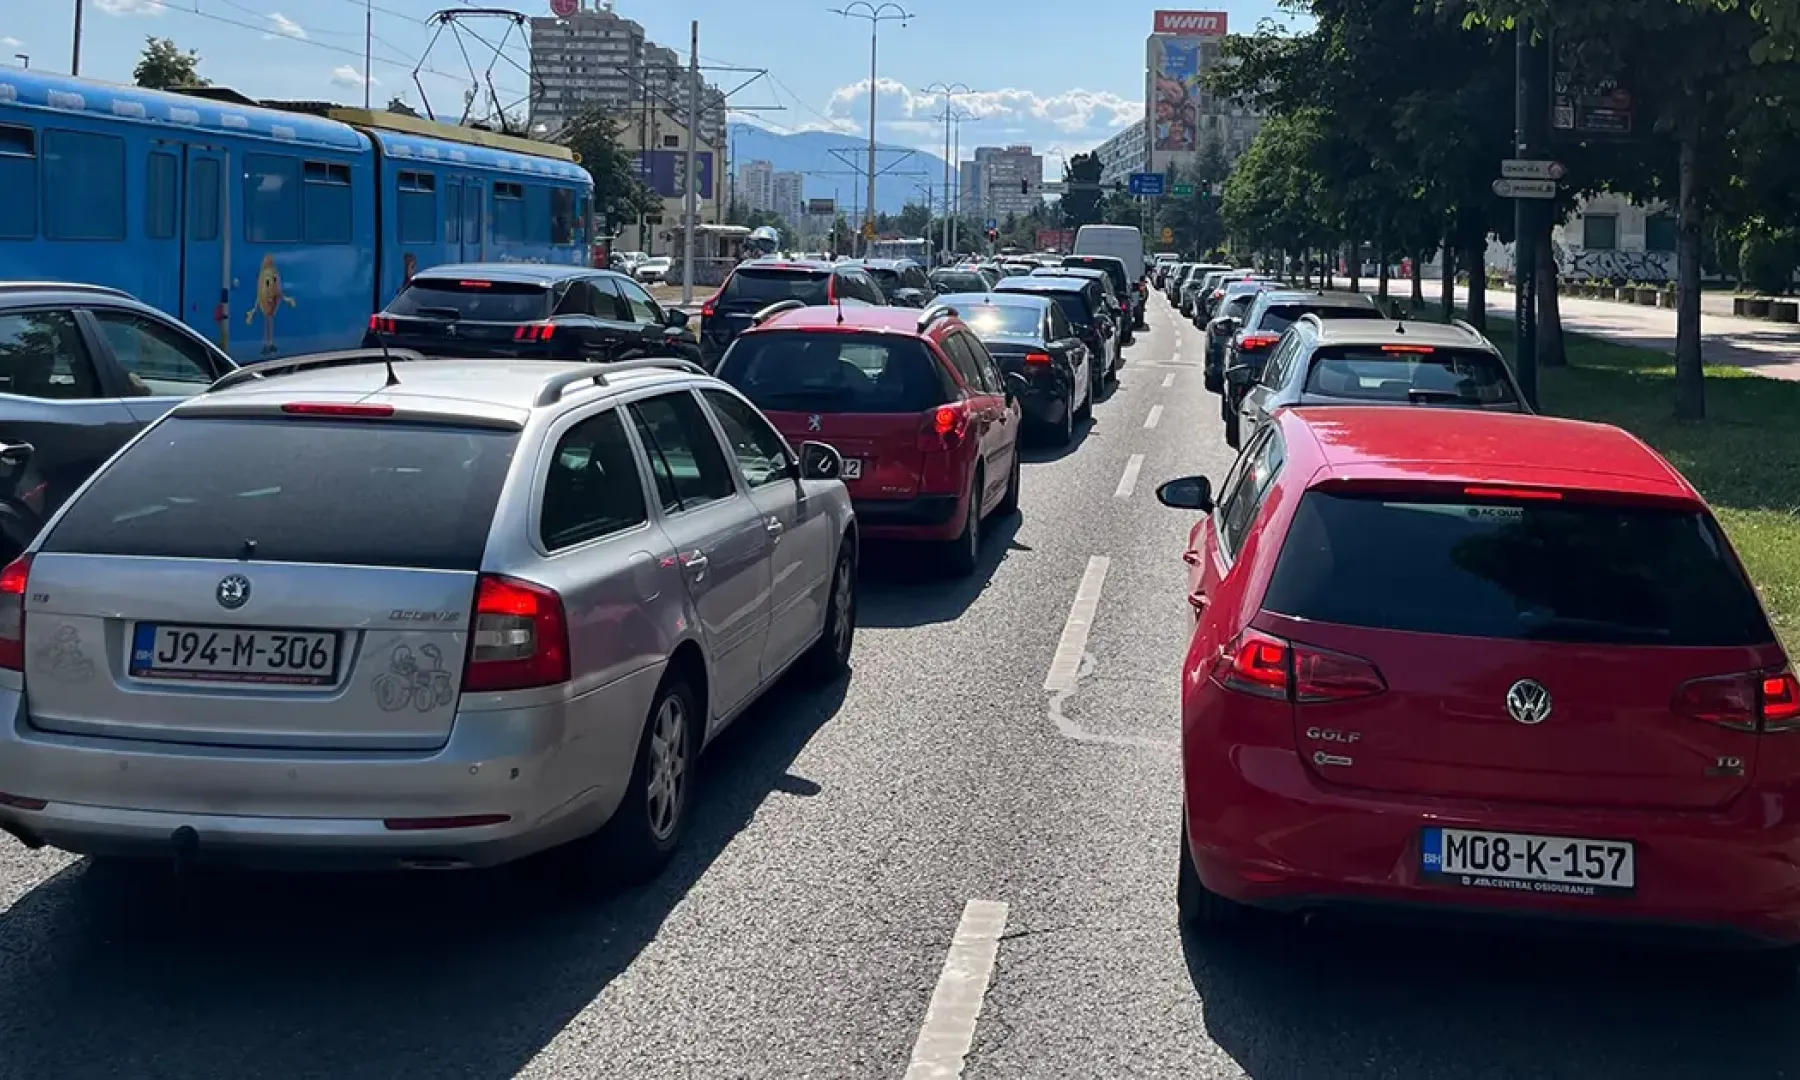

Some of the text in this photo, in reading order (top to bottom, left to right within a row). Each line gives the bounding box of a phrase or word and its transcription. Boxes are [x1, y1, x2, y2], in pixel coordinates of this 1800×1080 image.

[580, 0, 612, 14] LG
[158, 630, 328, 669] J94-M-306
[1306, 727, 1360, 743] GOLF
[1423, 853, 1441, 865] BIH
[1446, 834, 1626, 881] M08-K-157
[1534, 882, 1594, 896] OSIGURANJE
